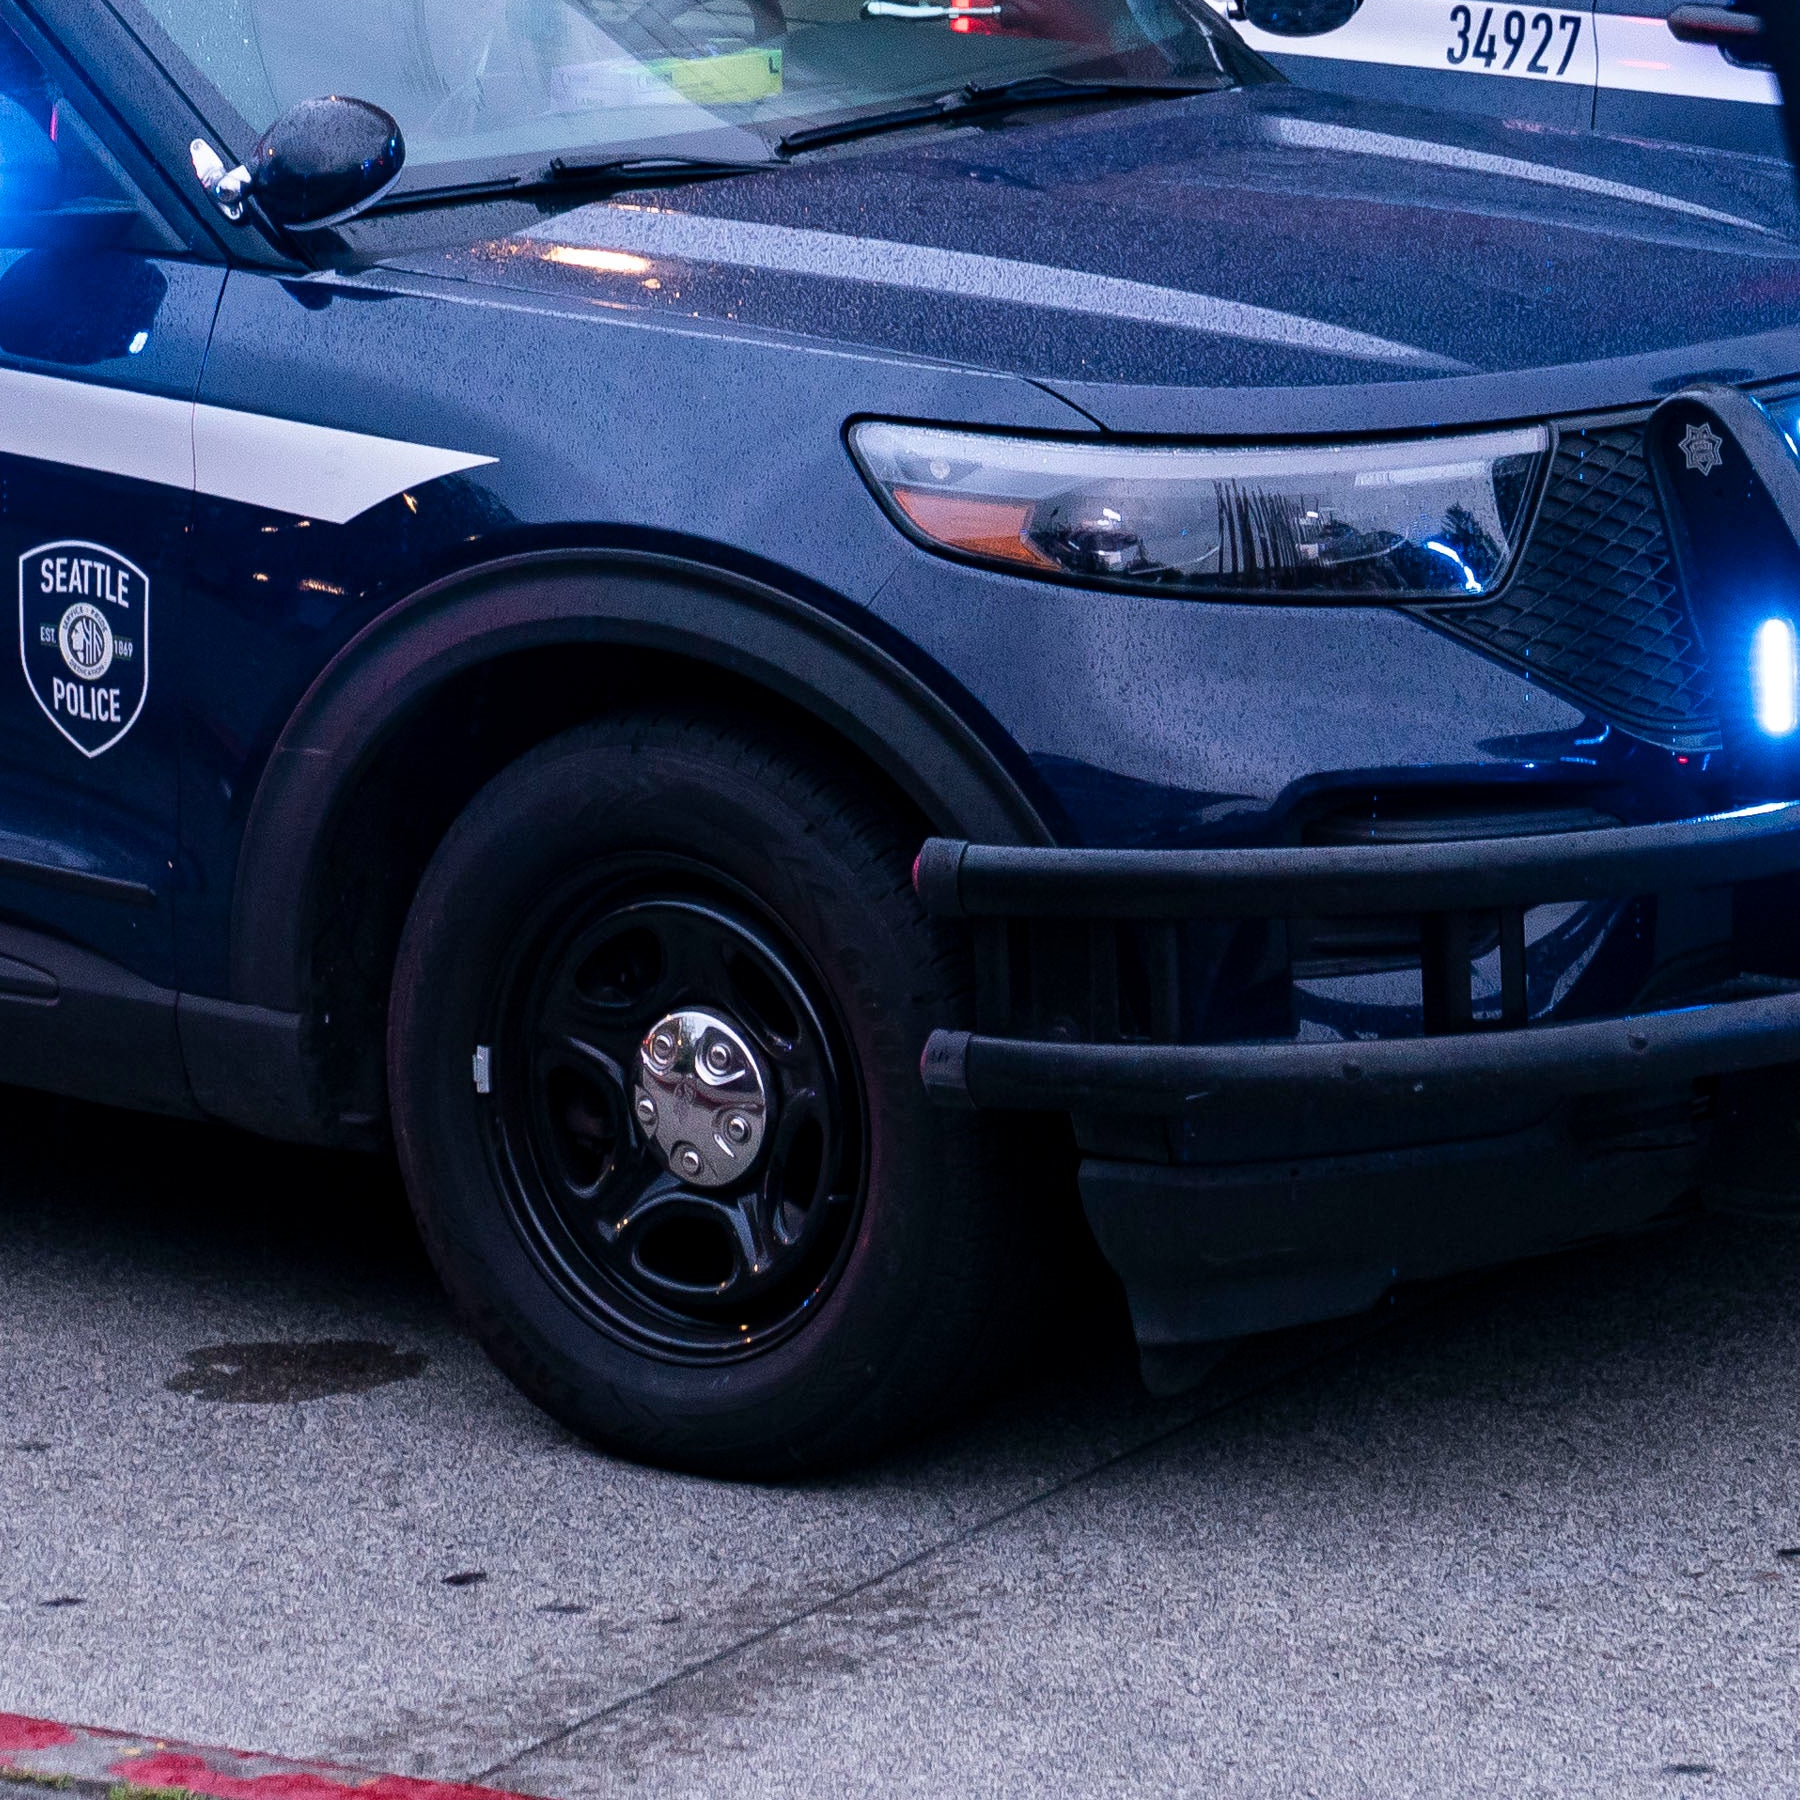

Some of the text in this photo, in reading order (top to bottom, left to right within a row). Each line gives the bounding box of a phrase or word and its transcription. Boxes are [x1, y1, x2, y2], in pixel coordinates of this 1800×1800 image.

[1446, 4, 1582, 76] 34927
[41, 558, 129, 608] SEATTLE
[40, 627, 133, 658] EST. 1869
[53, 676, 121, 723] POLICE
